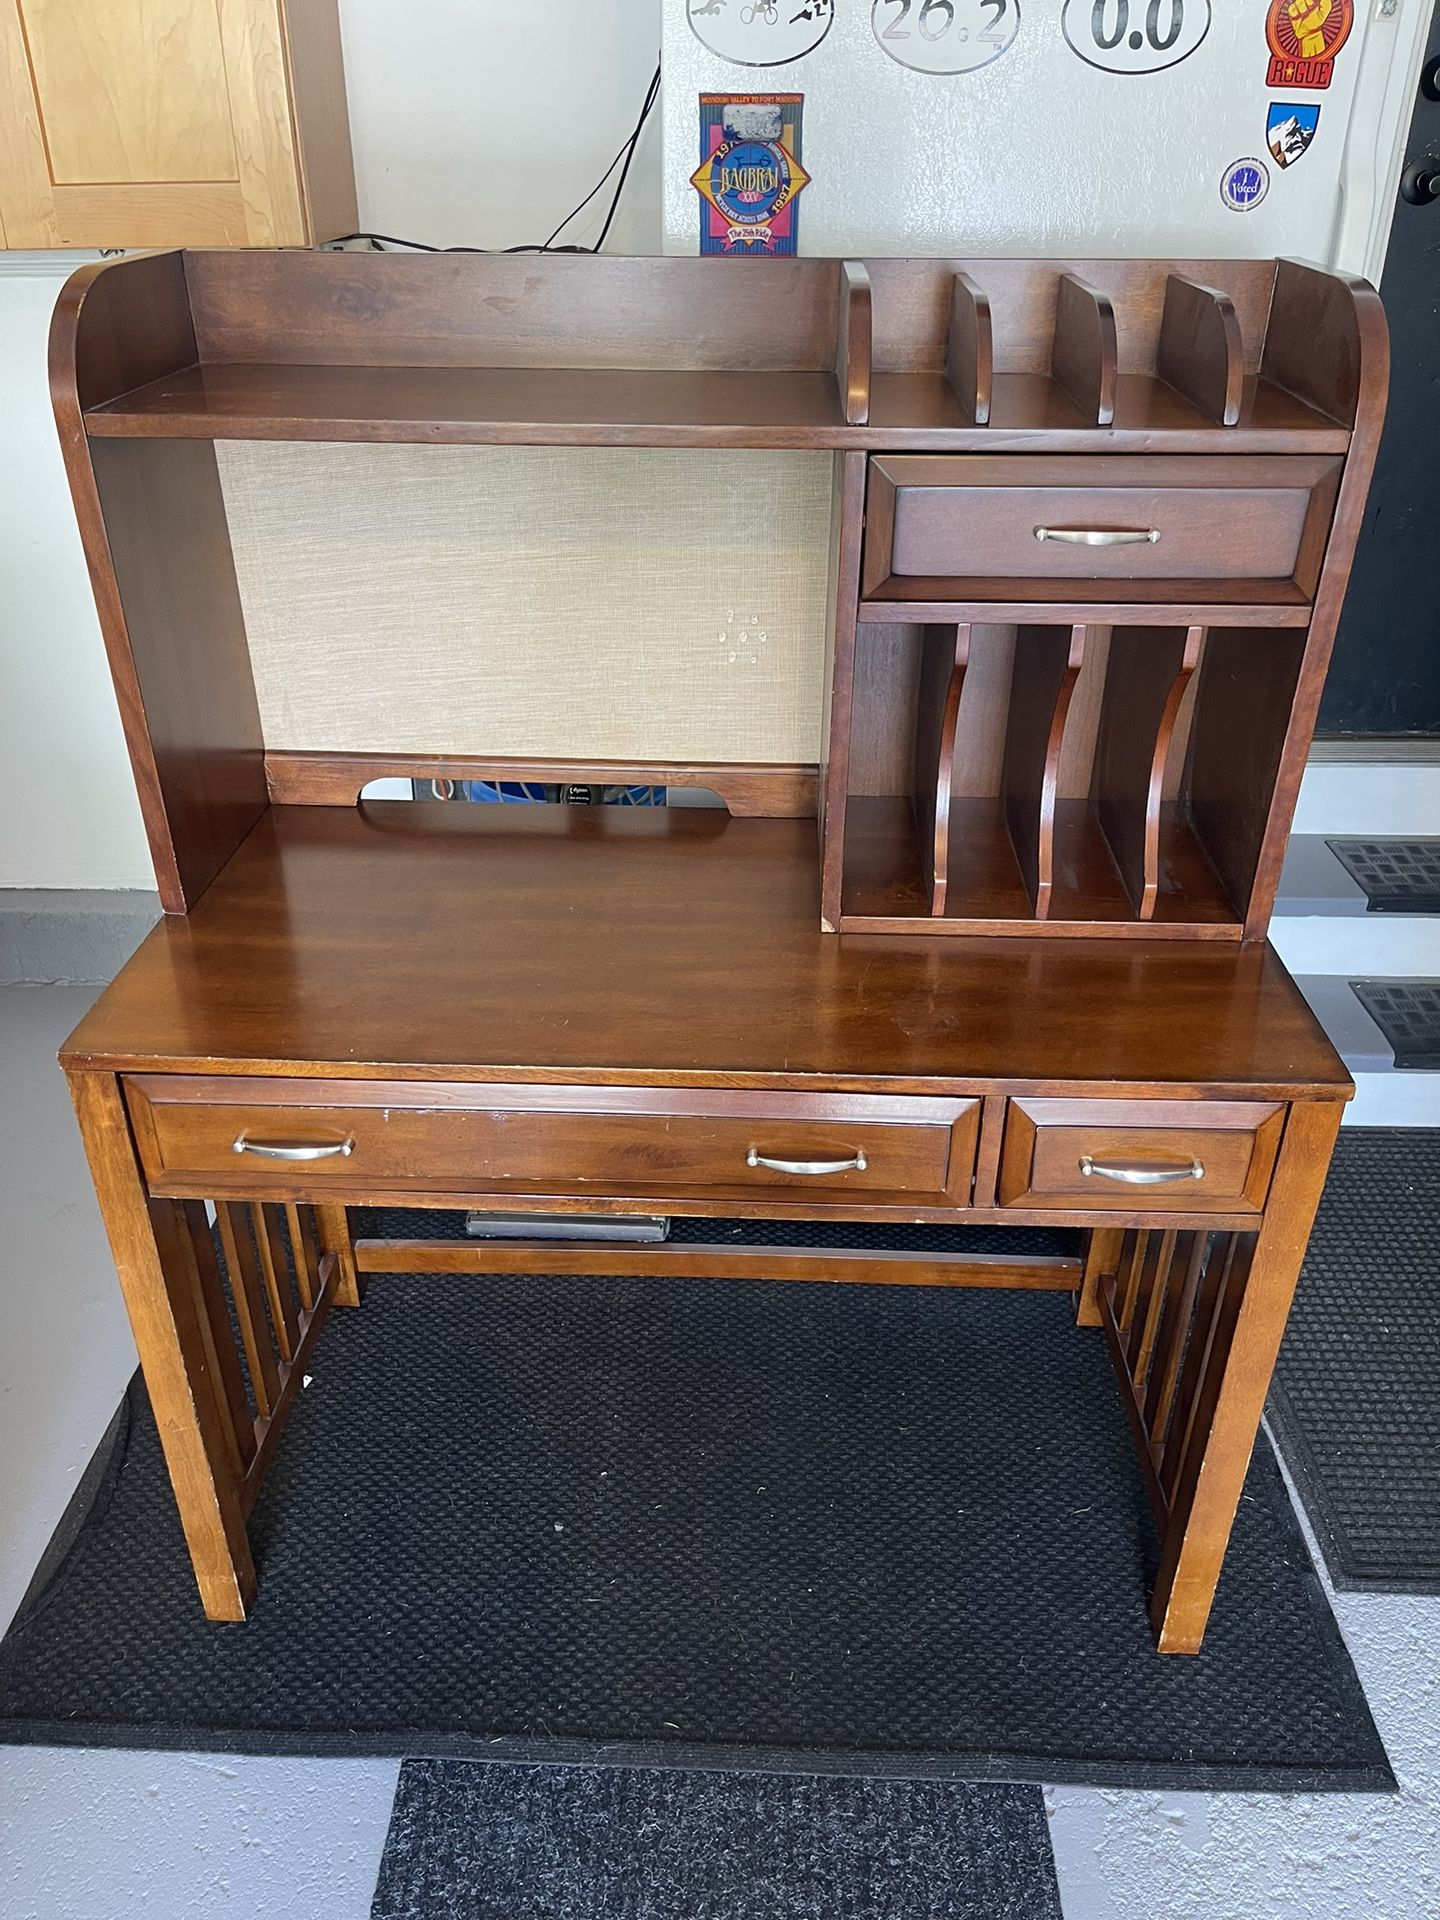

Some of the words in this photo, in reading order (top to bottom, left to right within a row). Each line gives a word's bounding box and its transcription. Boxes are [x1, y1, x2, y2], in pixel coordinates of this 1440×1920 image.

[881, 0, 1007, 42] 26.2
[1270, 60, 1330, 85] ROGUE
[730, 96, 750, 104] VALLEY
[760, 95, 775, 103] FORT
[775, 95, 801, 103] MADISON
[1232, 181, 1258, 193] Voted
[742, 191, 759, 202] XXV
[771, 184, 790, 214] 1997
[729, 229, 741, 238] The
[741, 228, 754, 237] 25th
[755, 229, 770, 238] Ride
